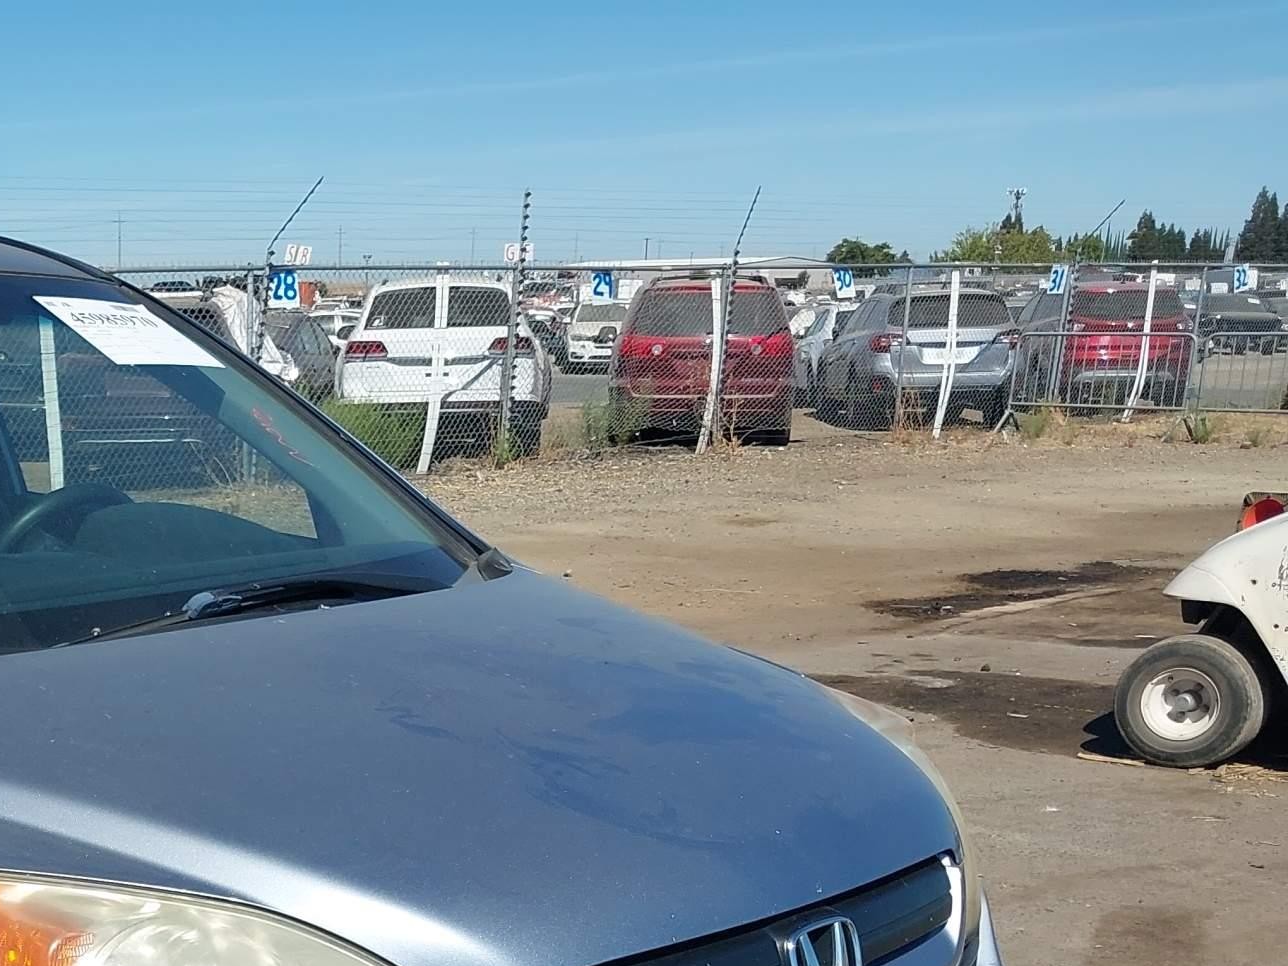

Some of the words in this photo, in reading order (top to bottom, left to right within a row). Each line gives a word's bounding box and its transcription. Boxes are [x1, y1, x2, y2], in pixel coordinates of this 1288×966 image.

[270, 271, 297, 300] 28
[592, 270, 613, 298] 29
[833, 267, 852, 291] 30
[1049, 268, 1065, 292] 31
[1235, 268, 1249, 290] 32
[70, 312, 160, 328] 45985970
